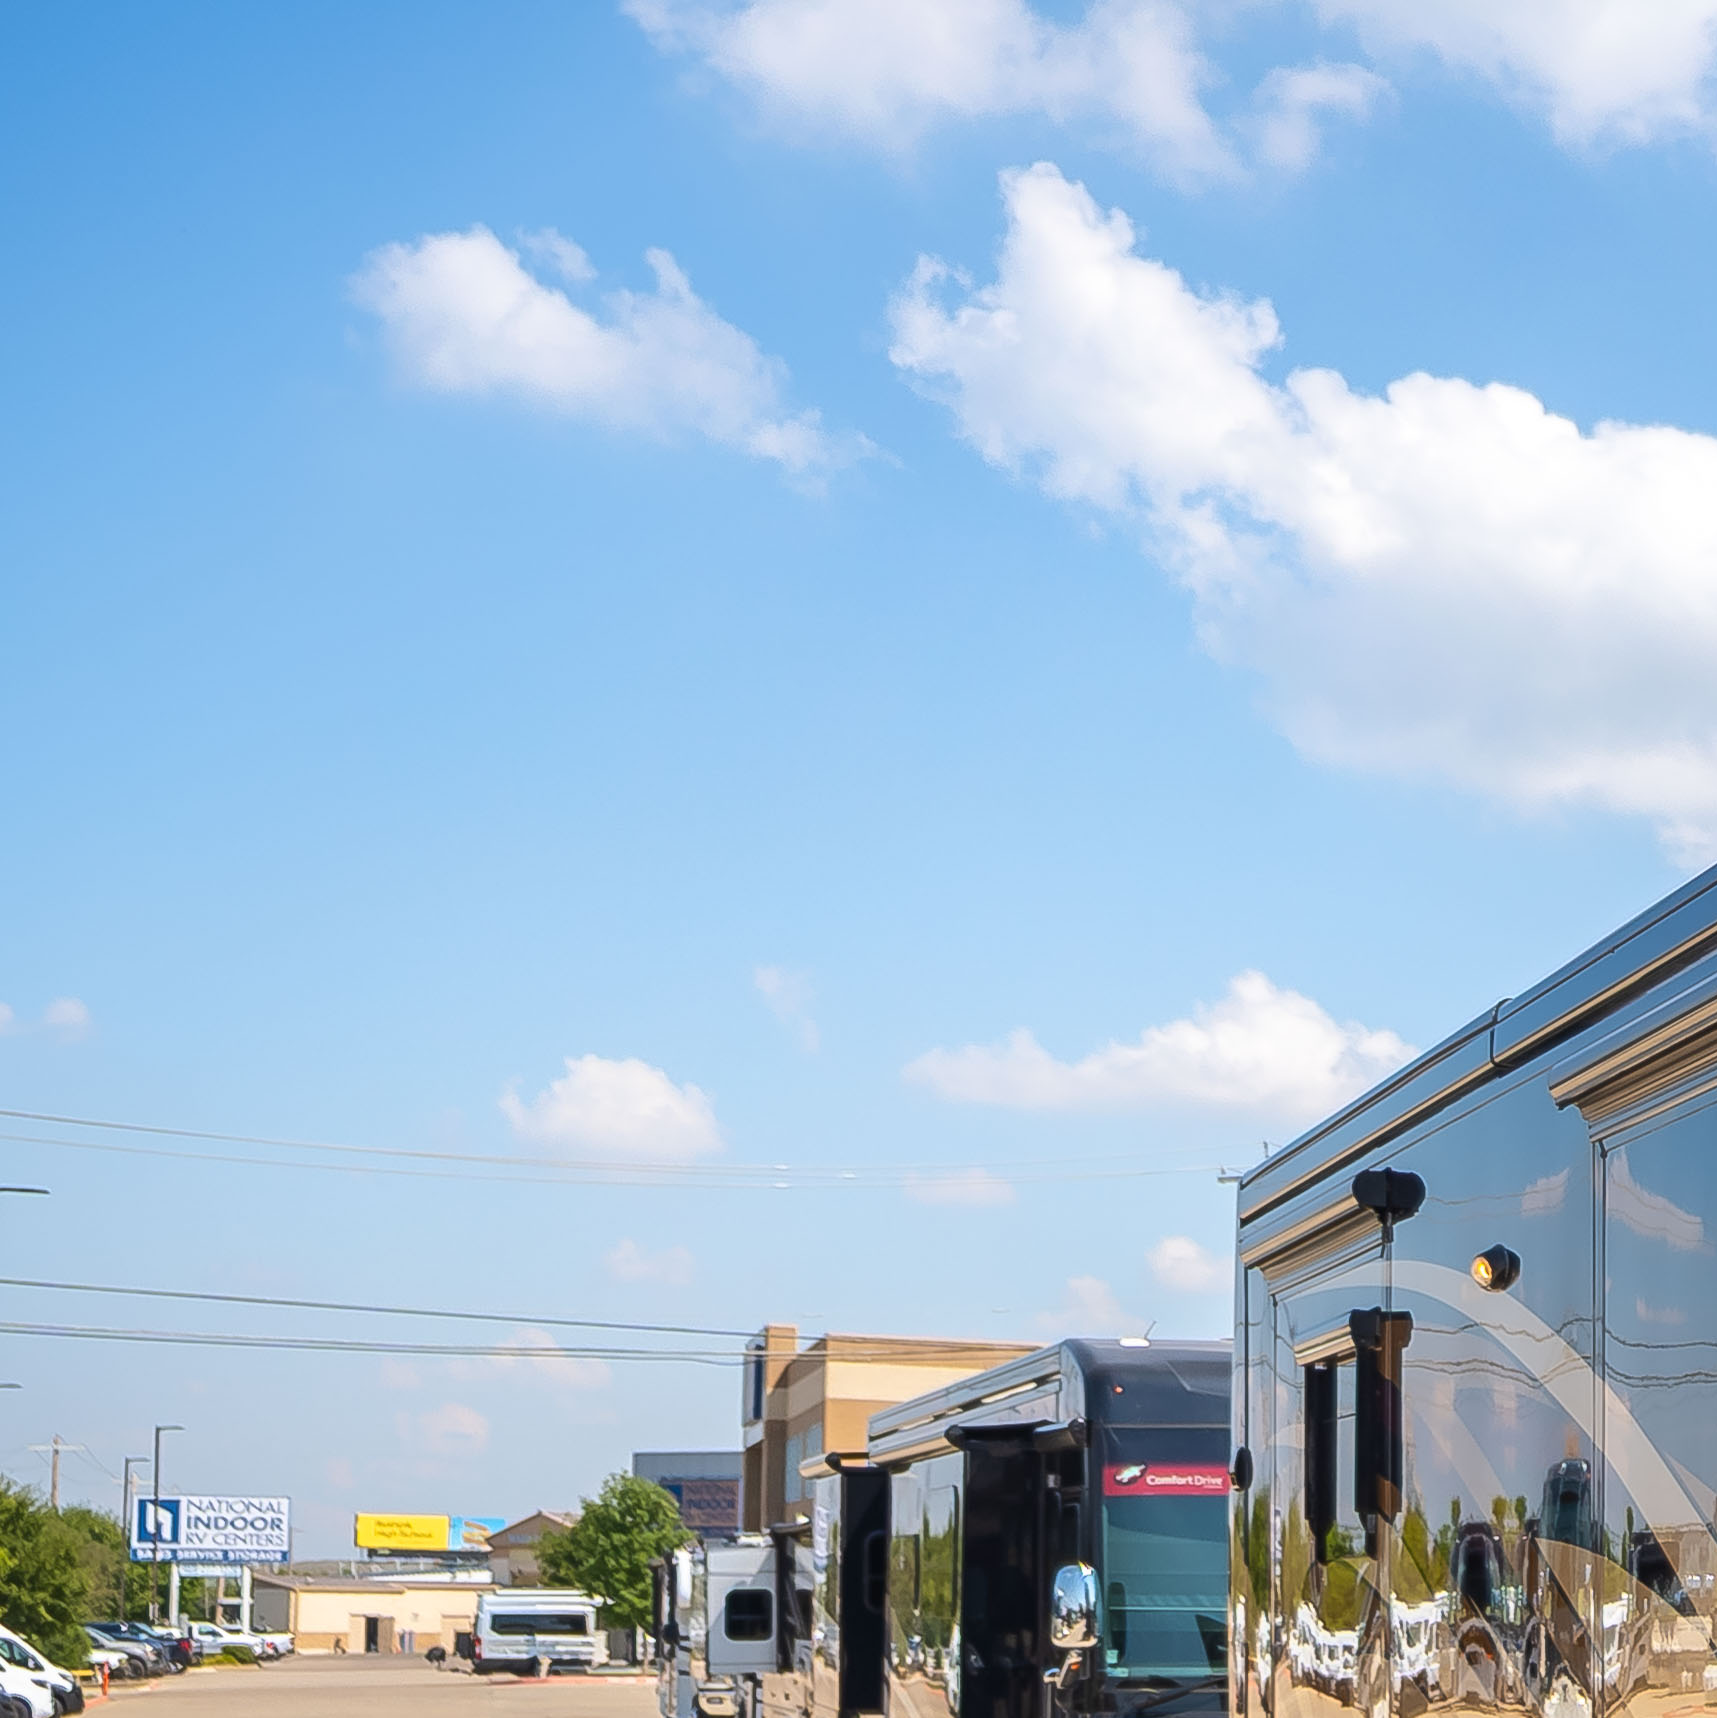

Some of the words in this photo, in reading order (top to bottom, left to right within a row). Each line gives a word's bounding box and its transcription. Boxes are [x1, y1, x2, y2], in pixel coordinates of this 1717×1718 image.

[1145, 1474, 1193, 1486] Comfort
[186, 1499, 285, 1515] NATIONAL
[186, 1516, 285, 1532] INDOOR
[186, 1532, 206, 1545] RV
[211, 1532, 285, 1547] CENTERS
